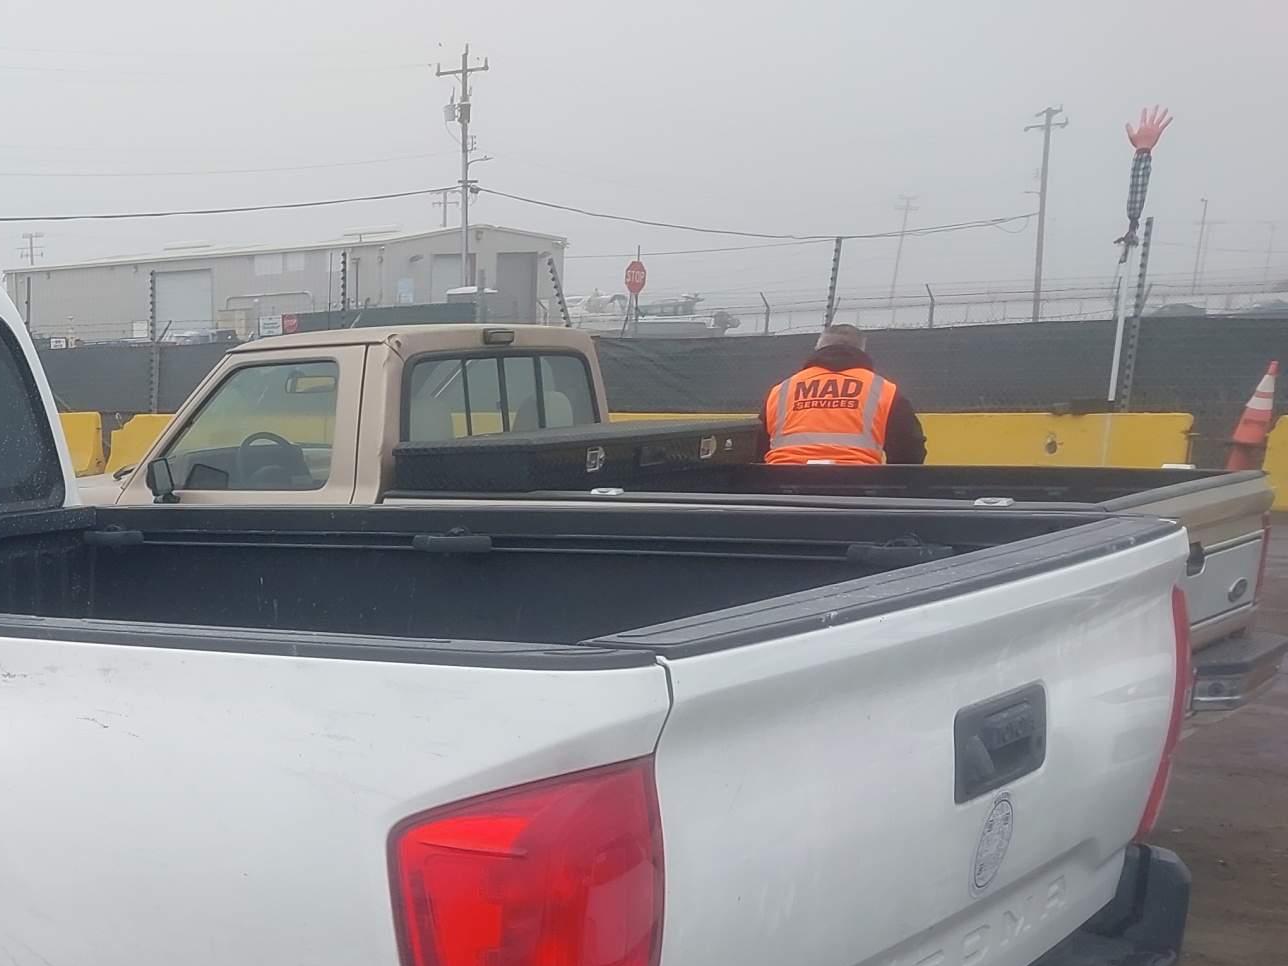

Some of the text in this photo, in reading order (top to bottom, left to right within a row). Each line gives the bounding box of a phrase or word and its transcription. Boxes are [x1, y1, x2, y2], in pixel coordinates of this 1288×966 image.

[626, 270, 645, 282] STOP
[795, 379, 864, 400] MAD
[796, 400, 855, 410] SERVICES
